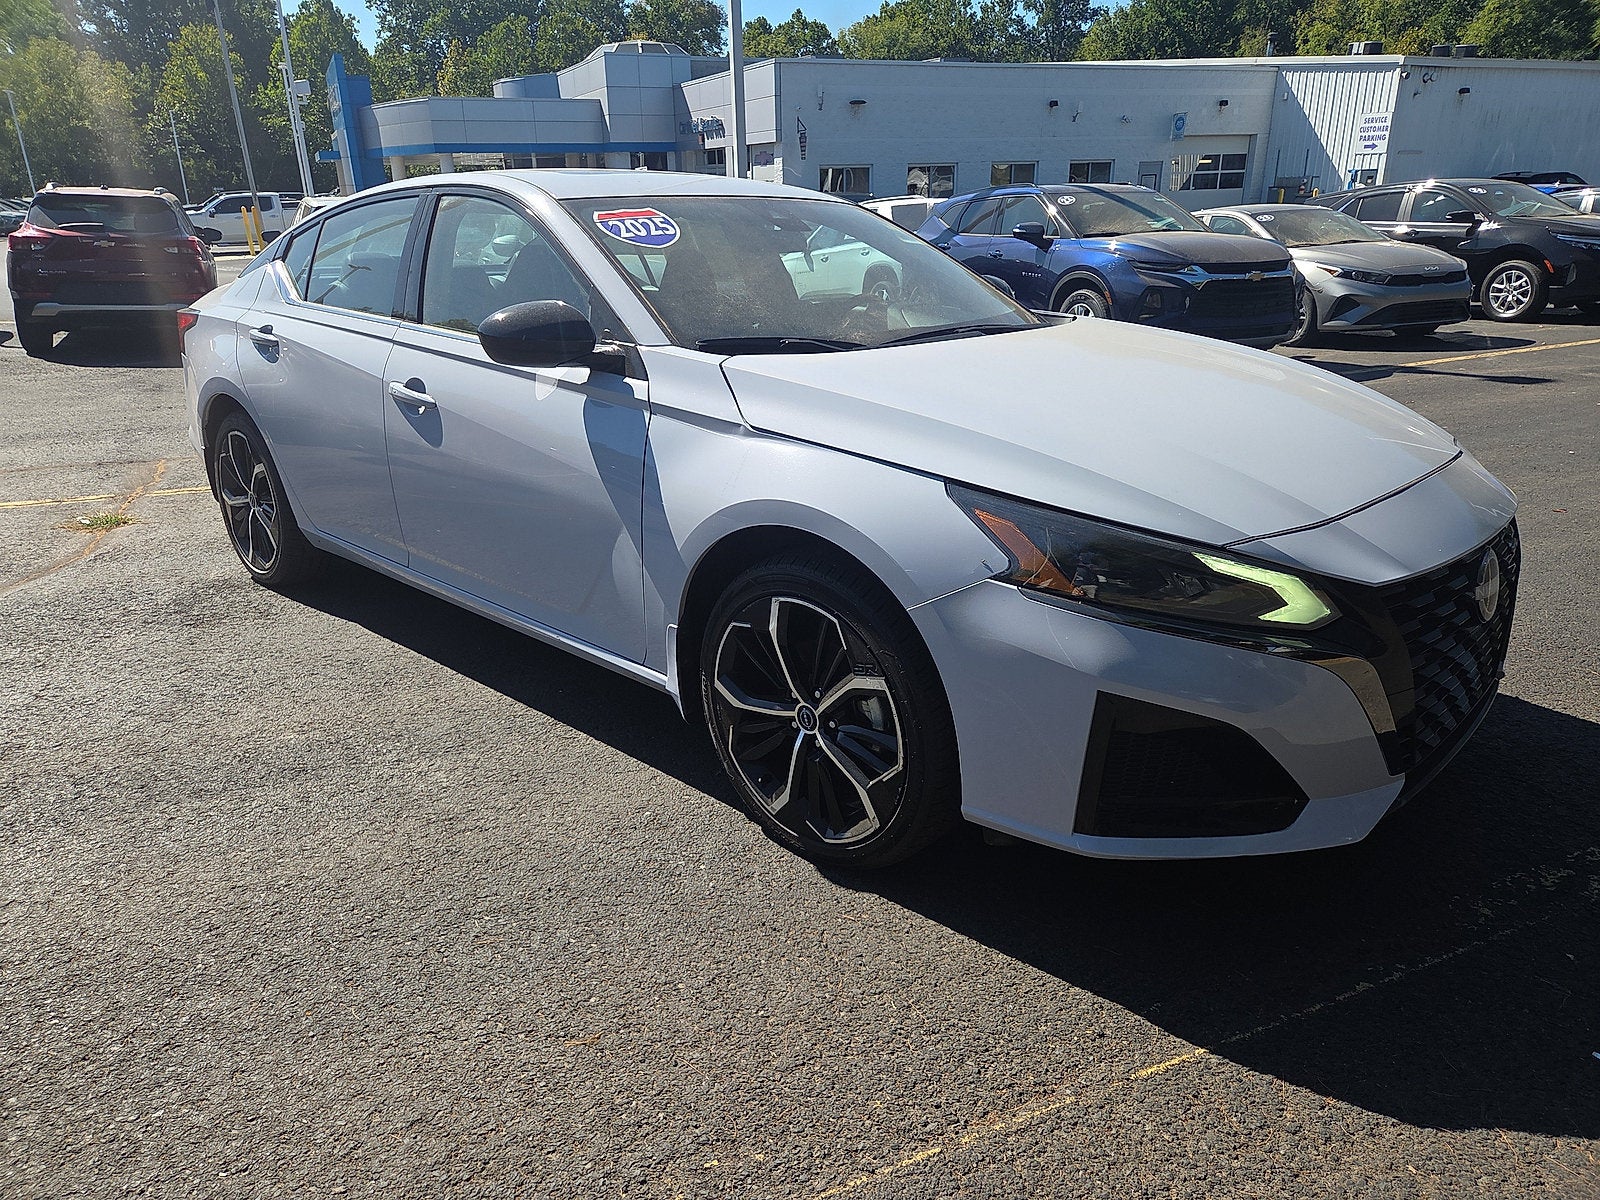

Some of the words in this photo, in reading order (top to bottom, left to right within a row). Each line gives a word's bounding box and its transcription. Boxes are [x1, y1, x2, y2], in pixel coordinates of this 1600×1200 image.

[1364, 116, 1387, 124] SERVICE
[1360, 125, 1389, 133] CUSTOMER
[1359, 134, 1386, 142] PARKING
[608, 218, 676, 238] 2025
